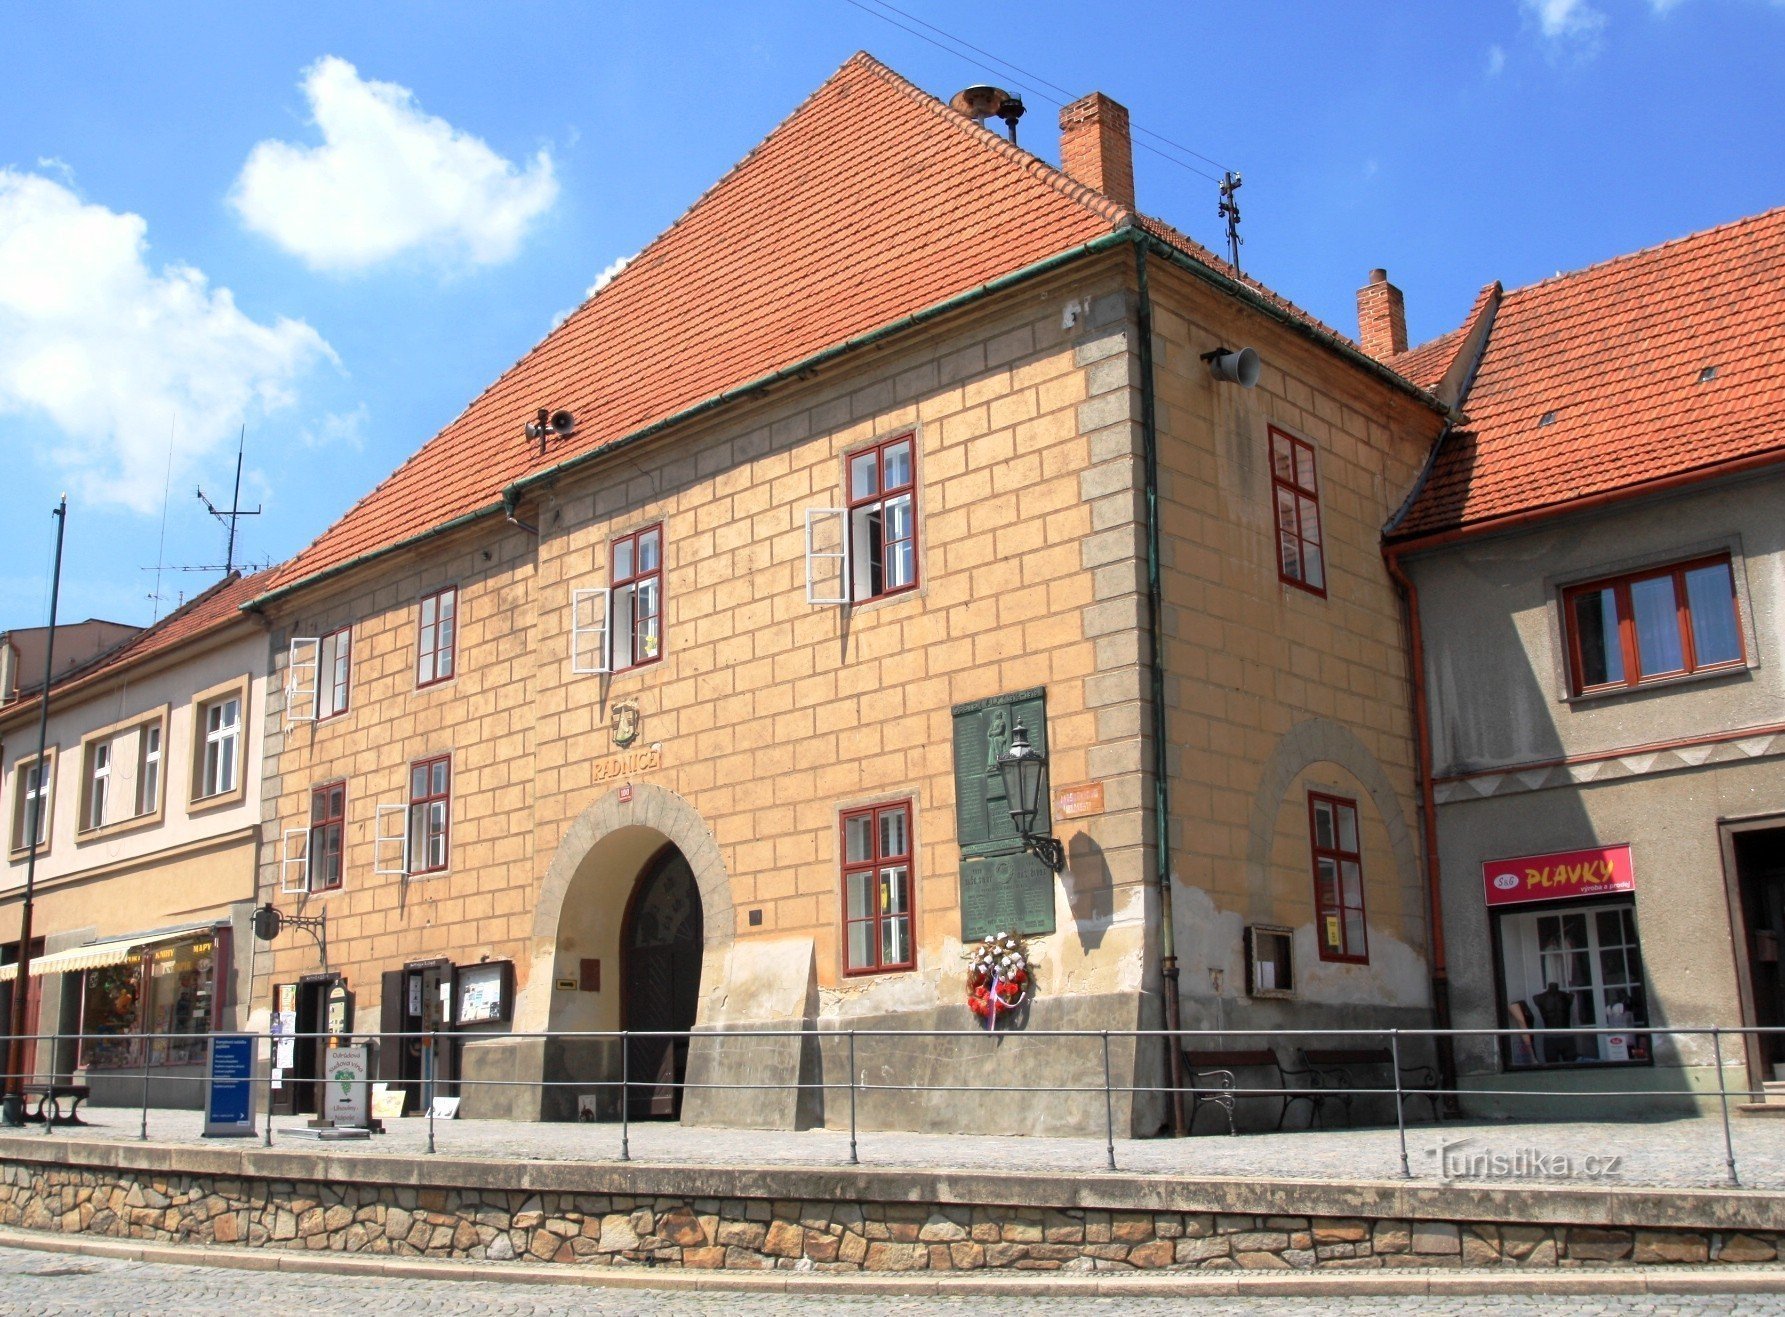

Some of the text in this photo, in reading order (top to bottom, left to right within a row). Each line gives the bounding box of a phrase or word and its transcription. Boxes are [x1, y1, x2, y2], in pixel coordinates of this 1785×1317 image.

[594, 750, 658, 781] RADNICE
[1524, 859, 1614, 889] PLAVKY
[1580, 884, 1602, 892] výroba
[1609, 881, 1631, 891] prodej
[193, 943, 212, 953] MAPY
